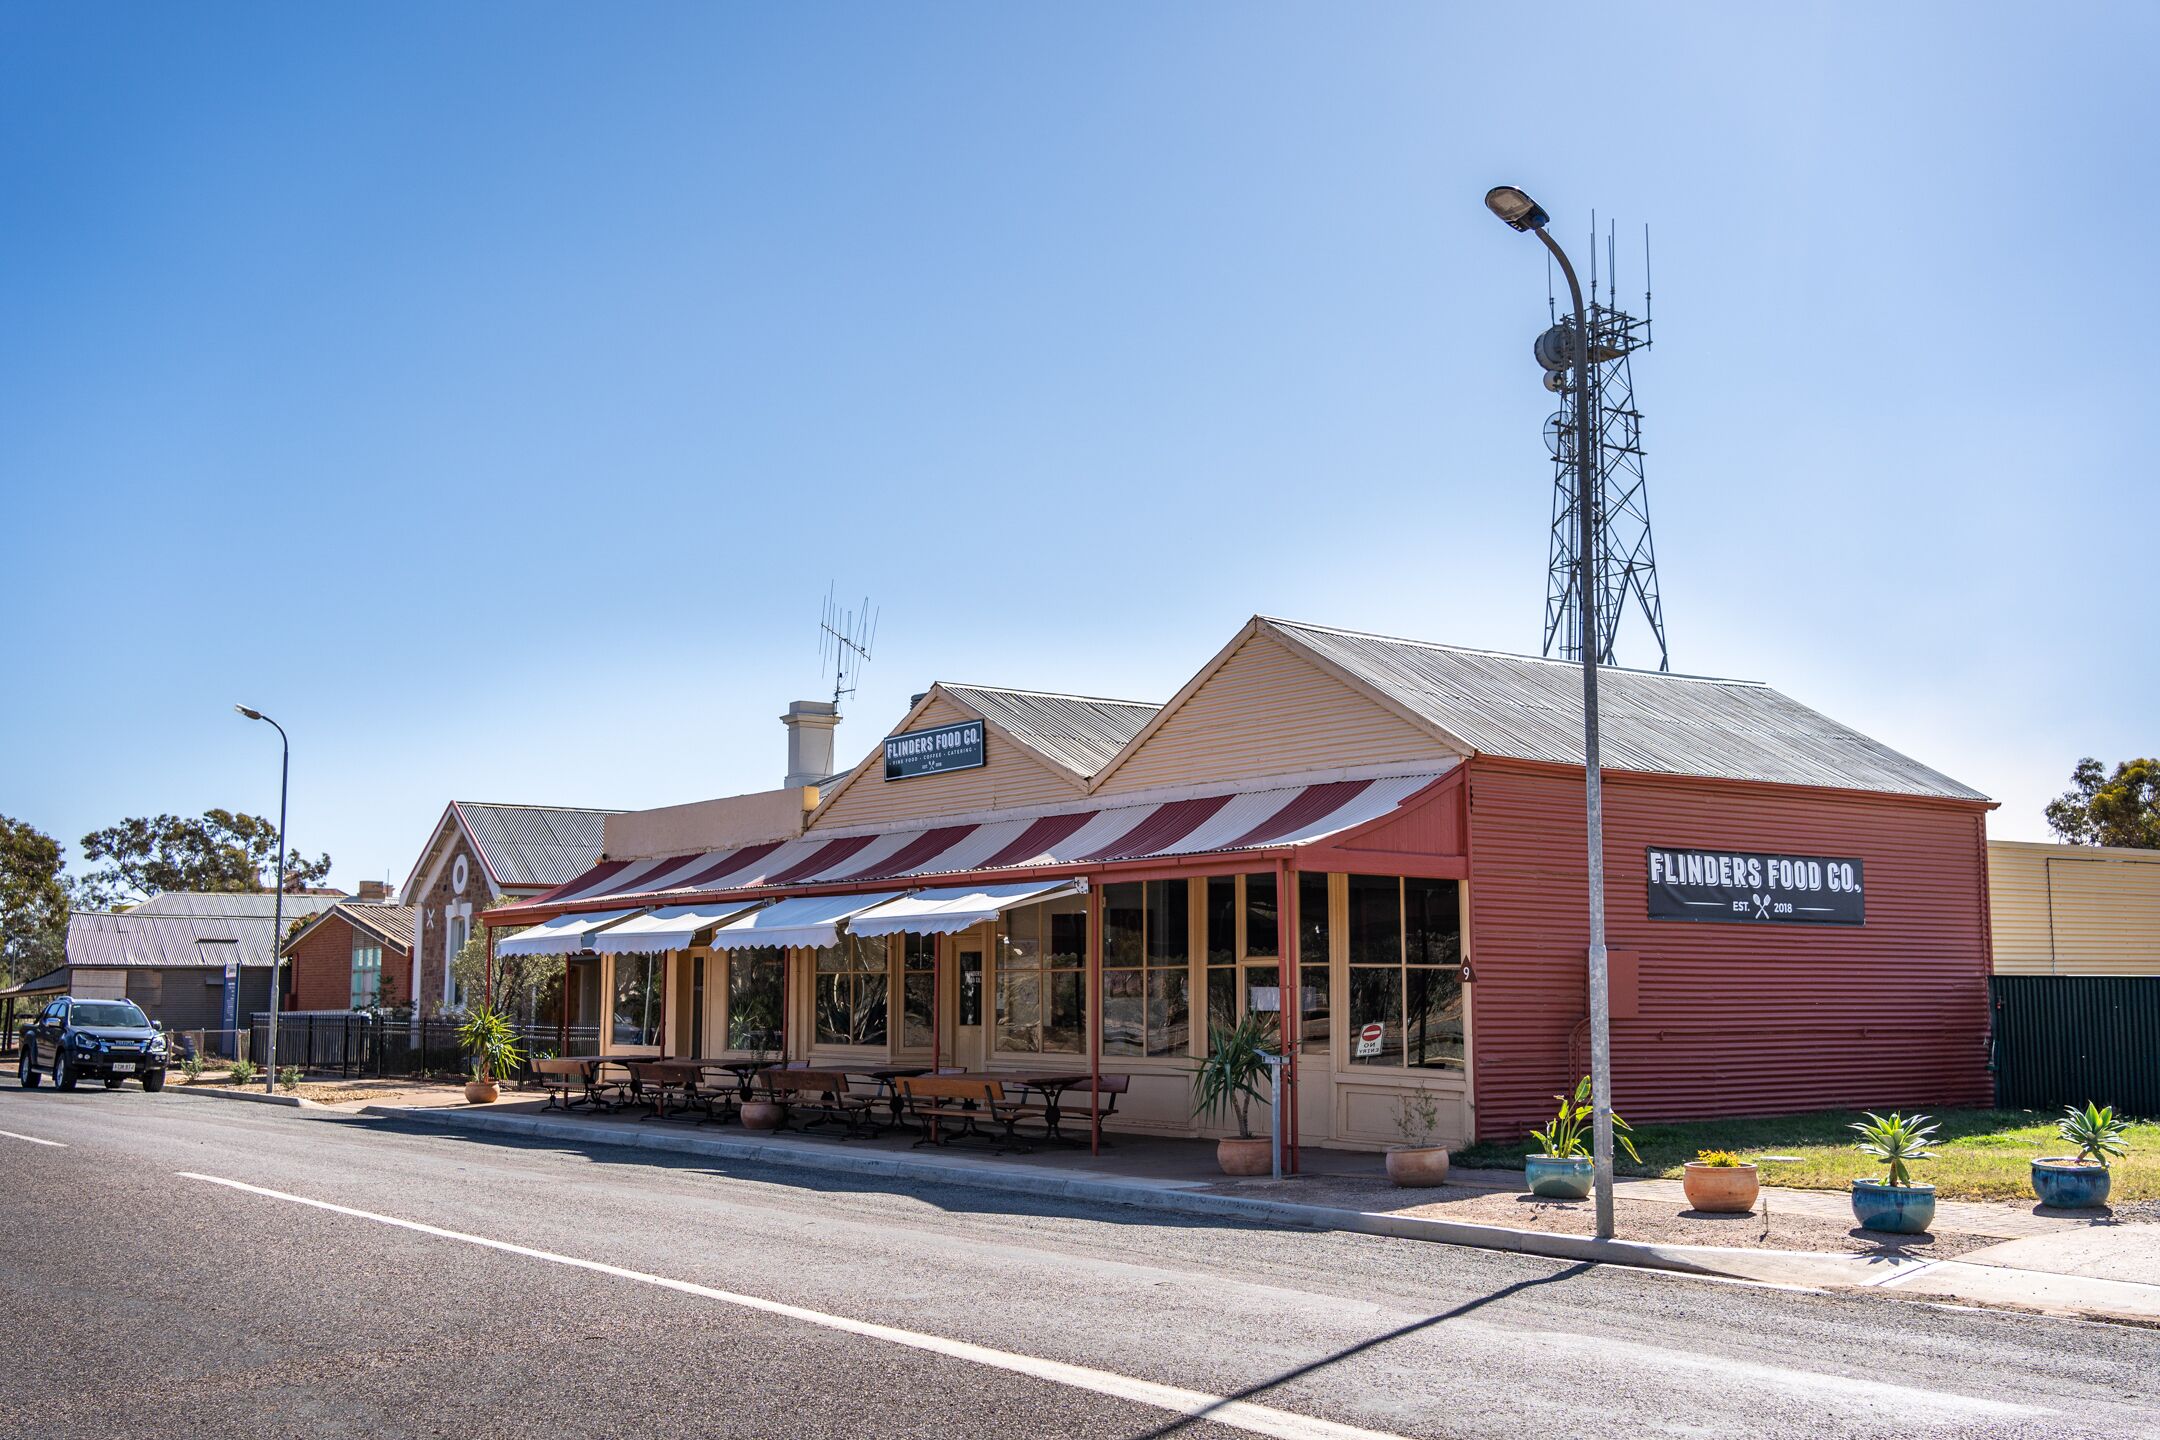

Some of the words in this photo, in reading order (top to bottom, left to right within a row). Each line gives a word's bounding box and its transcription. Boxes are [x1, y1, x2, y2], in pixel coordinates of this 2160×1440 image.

[887, 736, 933, 759] FLINDERS
[936, 731, 961, 750] FOOD
[963, 728, 980, 745] CO.
[947, 746, 973, 756] CATERING
[1650, 852, 1762, 888] FLINDERS
[1767, 858, 1822, 891] FOOD
[1827, 862, 1862, 892] CO.
[1732, 901, 1750, 912] EST.
[1773, 902, 1793, 913] 2018
[1463, 966, 1470, 980] 9
